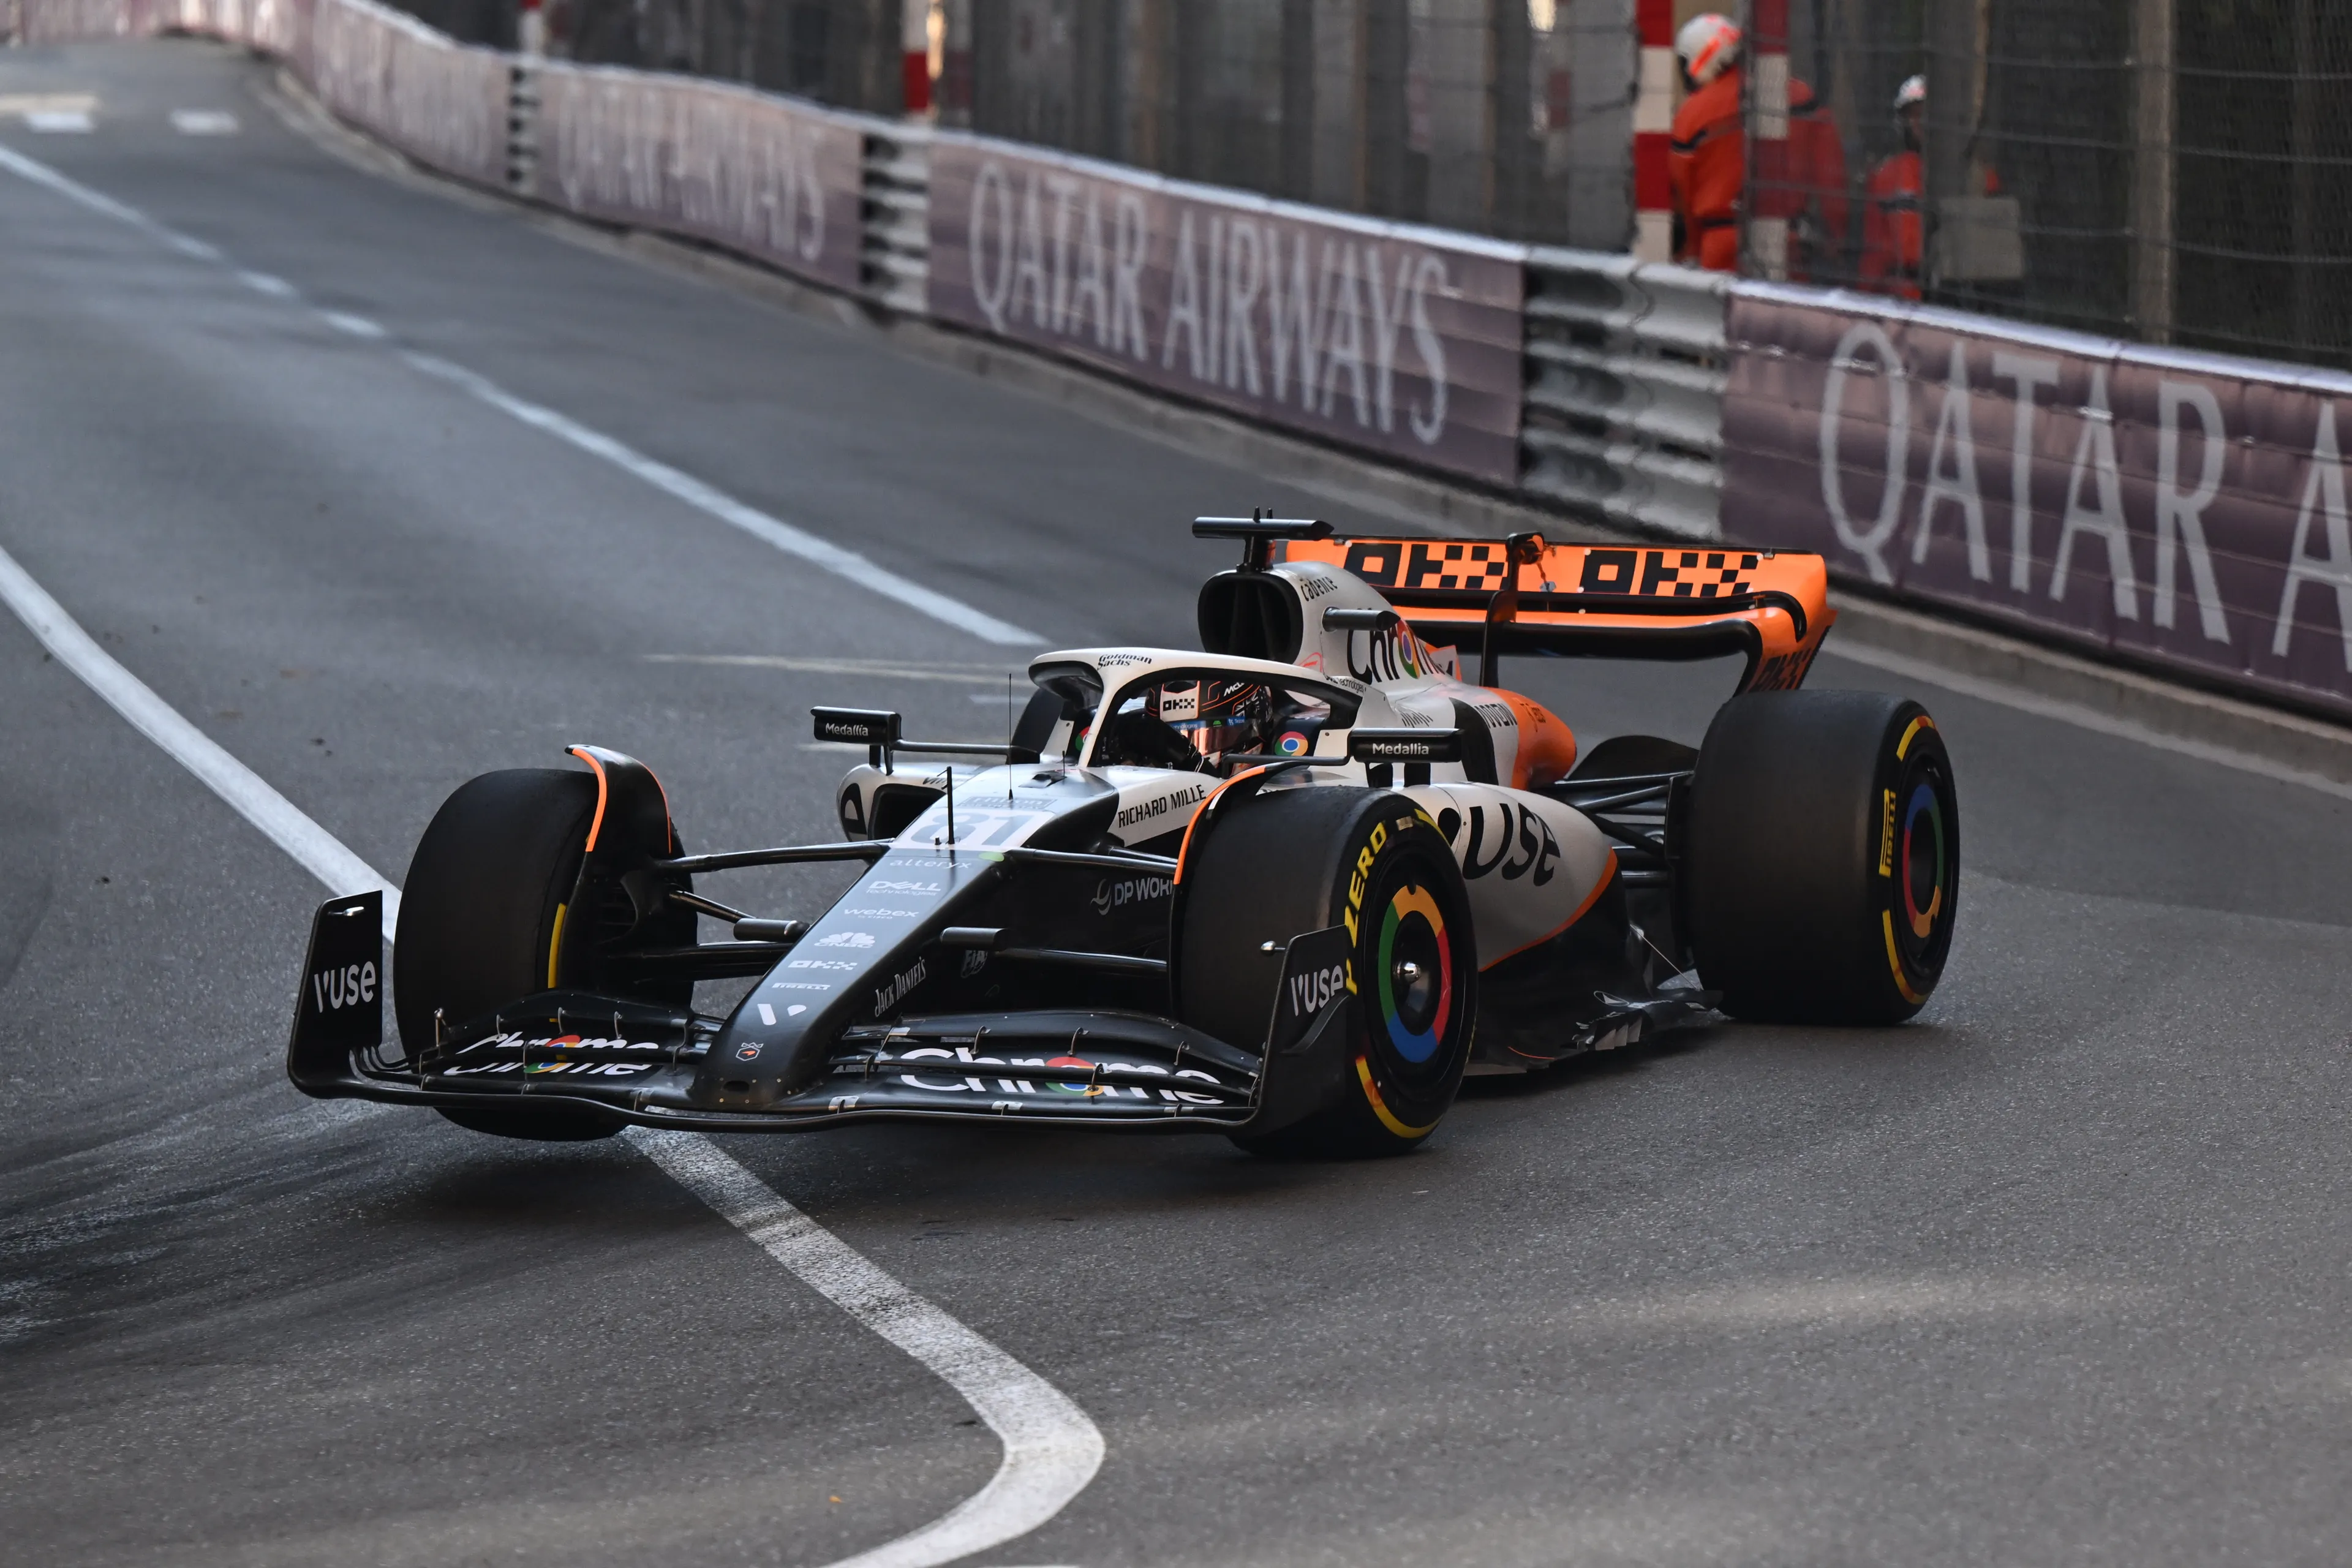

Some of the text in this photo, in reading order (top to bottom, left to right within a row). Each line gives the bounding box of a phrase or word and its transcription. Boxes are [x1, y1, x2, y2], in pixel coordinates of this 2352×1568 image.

[969, 161, 1448, 445] QATAR AIRWAYS
[1819, 323, 2231, 644] QATAR
[1580, 549, 1761, 598] OKX
[1099, 654, 1152, 664] Goldman
[1348, 609, 1444, 685] Chrom
[1097, 659, 1131, 671] Sachs
[1163, 699, 1195, 711] OKX
[825, 722, 869, 736] Medallia
[1372, 742, 1430, 755] Medallia
[1118, 784, 1207, 828] RICHARD MILLE
[911, 812, 1035, 846] 81
[1879, 788, 1896, 878] PIRELLI
[890, 859, 972, 869] alteryx
[869, 881, 941, 892] DELL
[1115, 881, 1134, 906] DP
[1344, 820, 1387, 949] ZERO
[844, 908, 919, 918] webex
[788, 960, 858, 970] OKX
[875, 956, 926, 1017] JACK DANIEL'S
